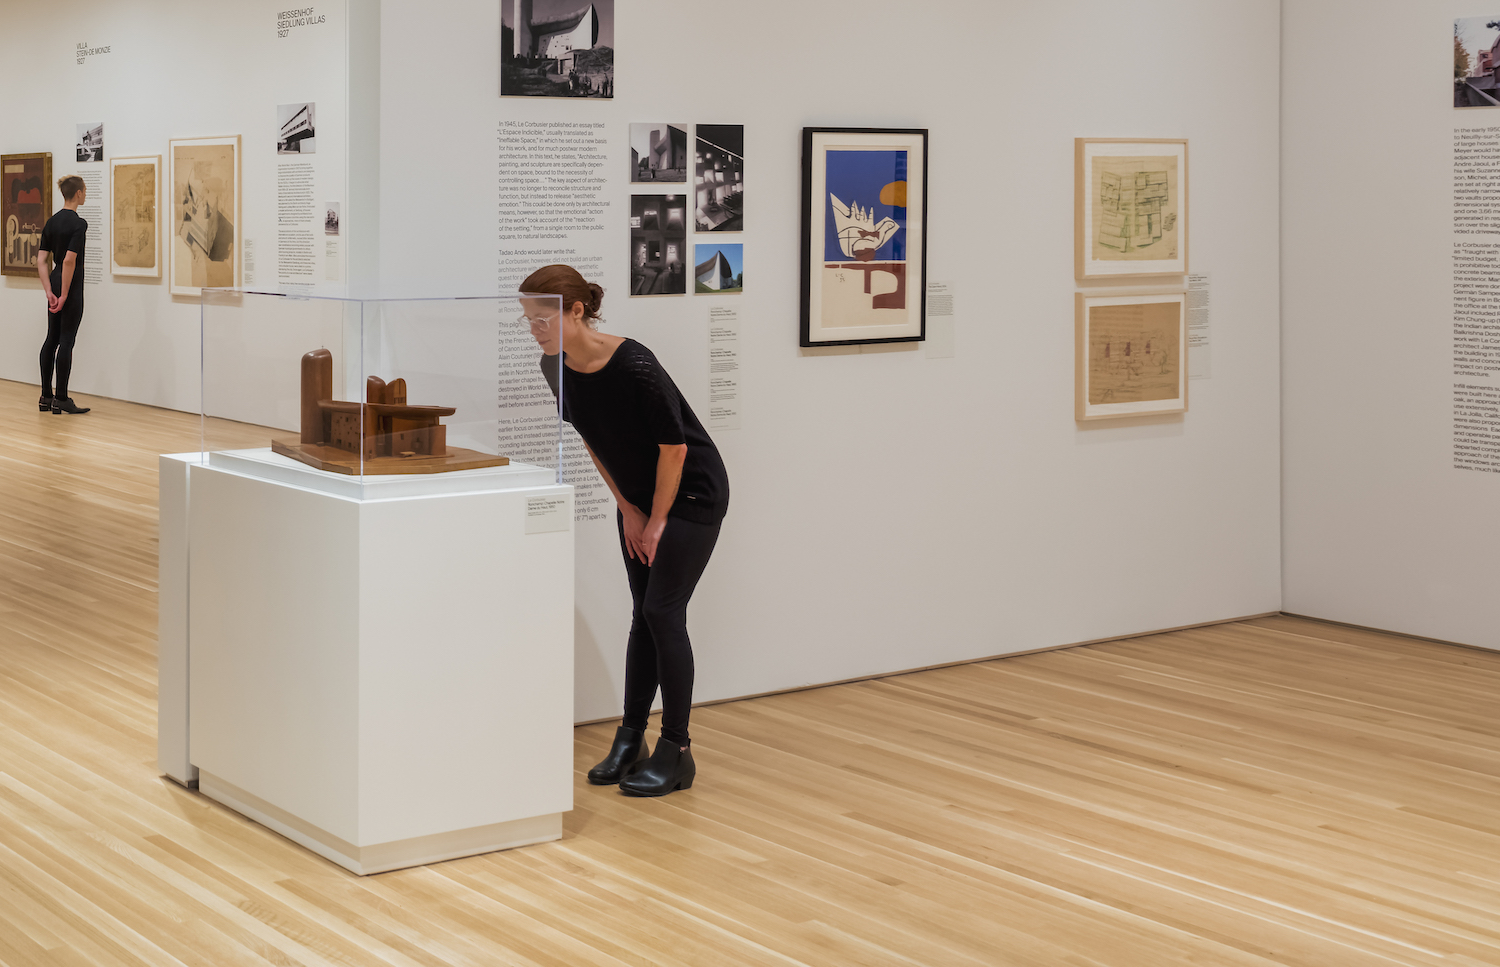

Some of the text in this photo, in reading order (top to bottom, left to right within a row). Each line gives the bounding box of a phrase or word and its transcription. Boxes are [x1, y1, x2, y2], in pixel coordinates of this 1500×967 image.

[277, 7, 314, 20] WEISSENHOF
[277, 14, 326, 30] SIEDLUNG VILLAS
[277, 29, 289, 38] 1927
[76, 42, 88, 50] VILLA
[549, 122, 572, 130] published
[546, 129, 563, 137] usually
[559, 145, 578, 153] postwar
[499, 161, 519, 169] painting,
[530, 161, 552, 169] sculpture
[561, 161, 587, 169] specifically
[587, 161, 604, 169] depen-
[566, 169, 588, 177] necessity
[526, 185, 542, 193] longer
